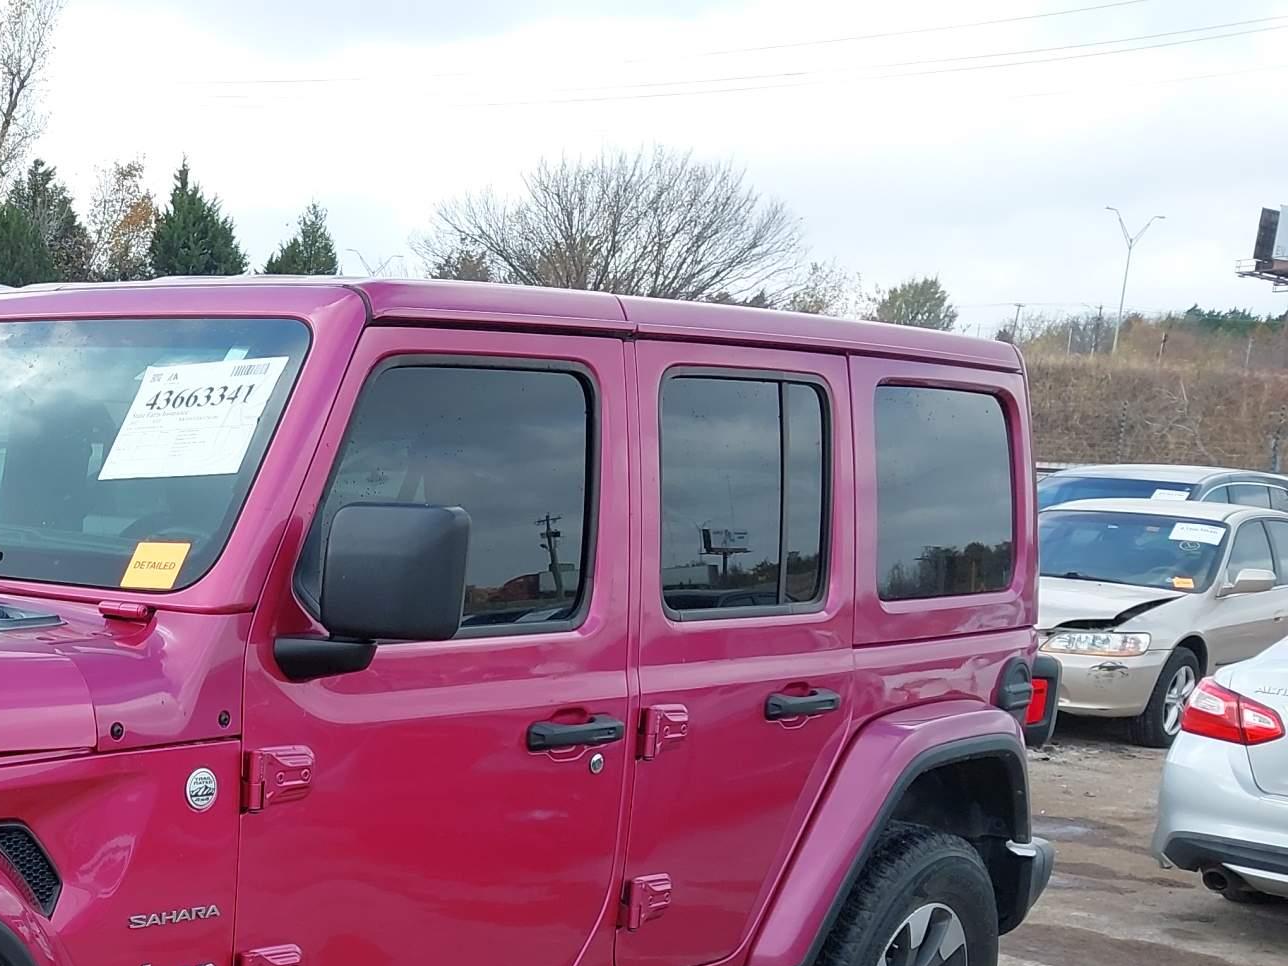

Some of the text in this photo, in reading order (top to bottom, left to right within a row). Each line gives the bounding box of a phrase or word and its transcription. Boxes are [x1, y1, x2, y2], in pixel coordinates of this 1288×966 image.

[145, 383, 256, 411] 43663341
[133, 560, 176, 571] DETAILED
[128, 905, 221, 929] SAHARA
